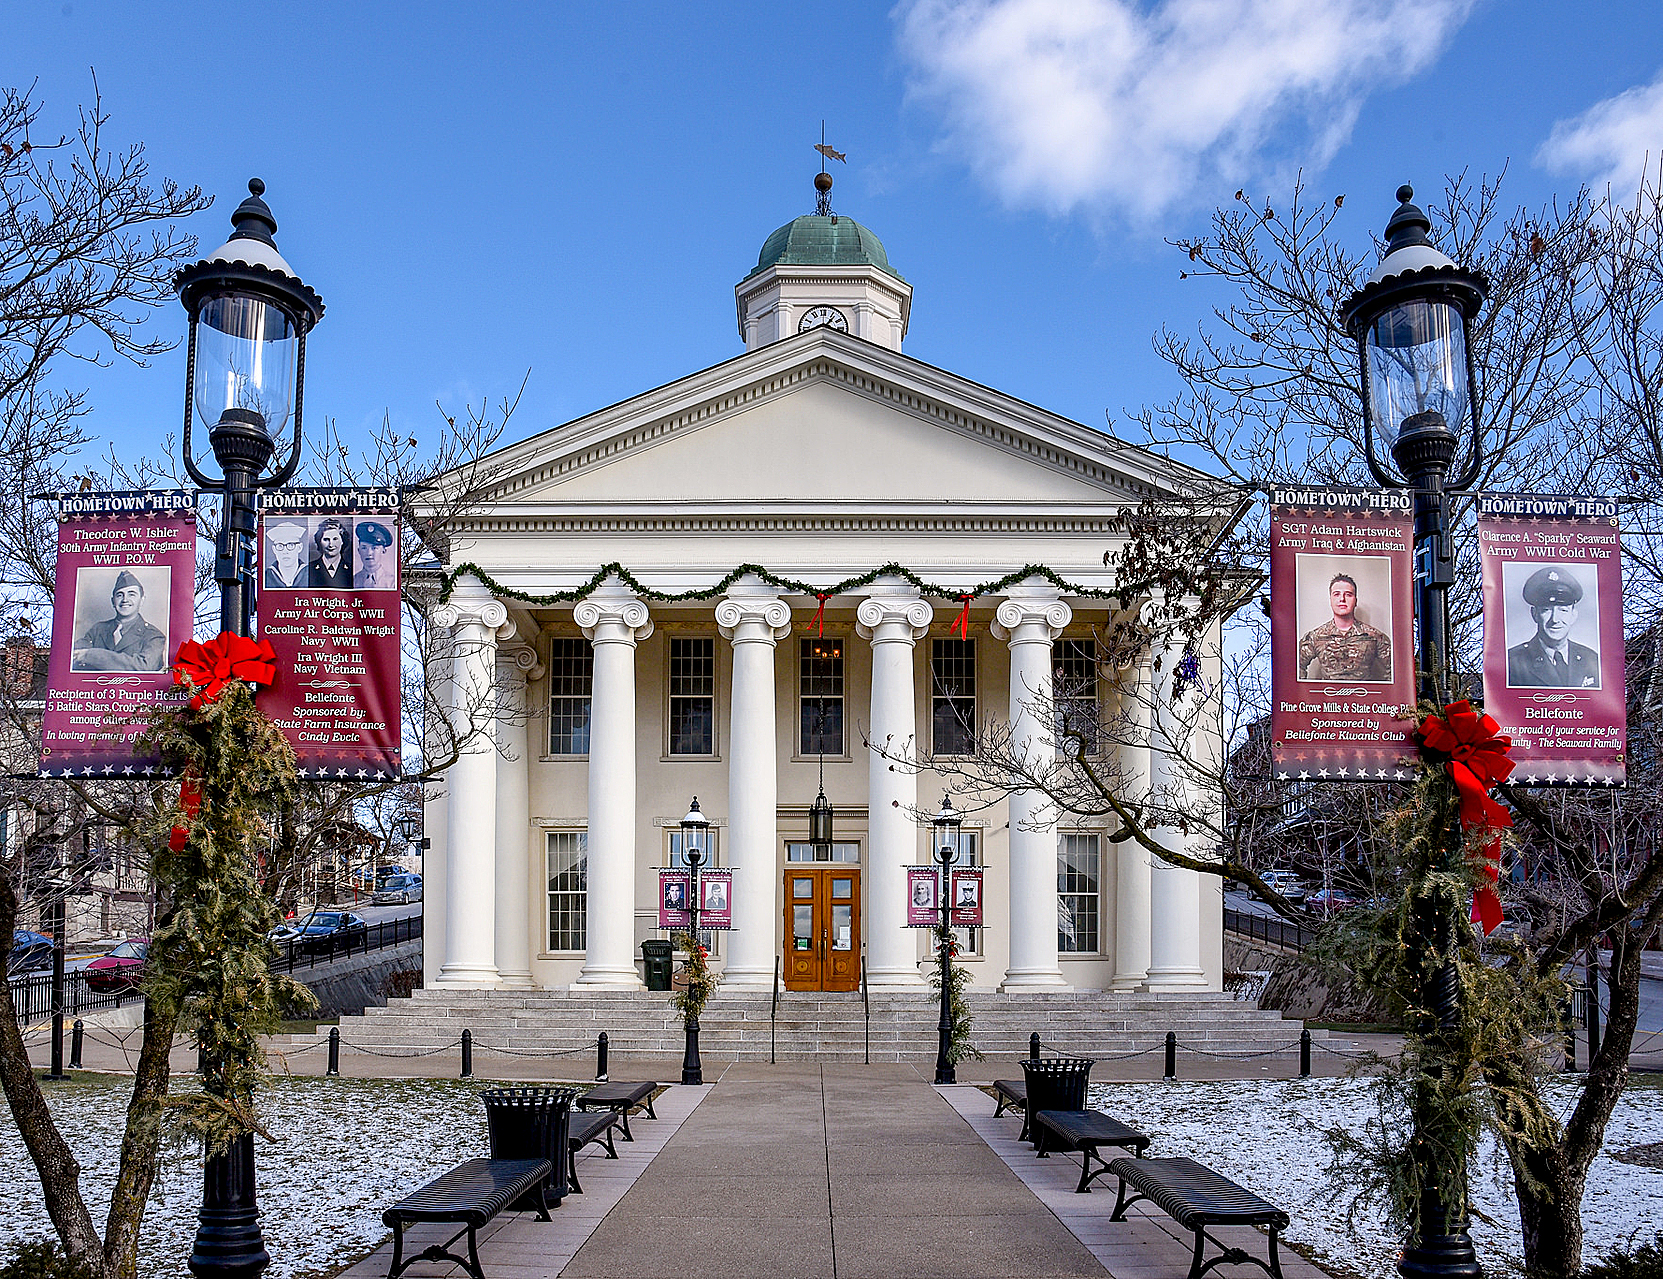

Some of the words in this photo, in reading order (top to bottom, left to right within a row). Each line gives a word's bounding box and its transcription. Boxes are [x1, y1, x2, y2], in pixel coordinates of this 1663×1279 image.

[63, 496, 144, 512] HOMETOWN
[153, 495, 193, 509] HERO
[263, 494, 349, 507] HOMETOWN
[357, 494, 398, 506] HERO
[1274, 491, 1362, 506] HOMETOWN
[1369, 495, 1410, 508] HERO
[1482, 499, 1567, 514] HOMETOWN
[1575, 503, 1615, 516] HERO
[74, 529, 126, 540] Theodore
[130, 528, 142, 538] W.
[146, 527, 179, 538] Ishler
[1282, 524, 1307, 534] SGT
[1310, 525, 1343, 535] Adam
[1346, 526, 1401, 537] Hartswick
[1482, 531, 1521, 541] Clarence
[1523, 532, 1532, 542] A.
[1534, 533, 1574, 545] "Sparky"
[1577, 534, 1616, 544] Seaward
[60, 543, 80, 553] 30th
[83, 543, 108, 554] Army
[110, 542, 146, 552] Infantry
[149, 541, 192, 553] Regiment
[1278, 537, 1306, 549] Army
[1312, 538, 1333, 550] Iraq
[1336, 539, 1344, 549] &
[1347, 540, 1405, 552] Afghanistan
[1487, 545, 1518, 558] Army
[1525, 546, 1555, 557] WWII
[1559, 547, 1585, 558] Cold
[1589, 548, 1611, 558] War
[94, 554, 120, 564] WWII
[126, 554, 156, 564] P.O.W.
[295, 597, 309, 606] Ira
[312, 598, 348, 609] Wright,
[352, 598, 364, 607] Jr.
[274, 609, 301, 620] Army
[304, 609, 320, 618] Air
[323, 609, 353, 620] Corps
[359, 609, 384, 618] WWII
[265, 625, 304, 634] Caroline
[308, 625, 318, 633] R.
[322, 625, 361, 634] Baldwin
[364, 626, 395, 637] Wright
[301, 636, 326, 647] Navy
[332, 637, 359, 646] WWII
[297, 653, 312, 661] Ira
[315, 653, 348, 664] Wright
[351, 654, 362, 662] III
[294, 664, 318, 675] Navy
[324, 664, 366, 674] Vietnam
[49, 689, 94, 701] Recipient
[97, 689, 107, 699] of
[109, 689, 115, 699] 3
[119, 689, 152, 702] Purple
[305, 693, 355, 703] Bellefonte
[48, 702, 54, 711] 5
[56, 702, 83, 711] Battle
[1280, 702, 1297, 712] Pine
[1299, 702, 1321, 712] Grove
[1323, 703, 1341, 712] Mills
[1343, 704, 1349, 712] &
[1351, 704, 1370, 713] State
[1372, 704, 1398, 717] College
[293, 707, 346, 718] Sponsored
[350, 708, 366, 719] by:
[1525, 708, 1583, 719] Bellefonte
[70, 716, 101, 727] among
[274, 719, 301, 728] State
[303, 720, 331, 729] Farm
[334, 720, 385, 730] Insurance
[1311, 718, 1364, 729] Sponsored
[1367, 720, 1379, 729] by
[46, 730, 56, 739] In
[58, 731, 85, 742] loving
[88, 733, 125, 742] memory
[128, 731, 138, 743] of
[1285, 730, 1336, 741] Bellefonte
[1338, 731, 1379, 740] Kiwanis
[1382, 732, 1405, 741] Club
[1518, 725, 1543, 736] proud
[1545, 725, 1554, 736] of
[1555, 726, 1574, 737] your
[1576, 726, 1605, 735] service
[1606, 726, 1619, 737] for
[298, 732, 329, 743] Cindy
[1539, 738, 1554, 747] The
[1556, 739, 1592, 748] Seaward
[1594, 739, 1621, 750] Family
